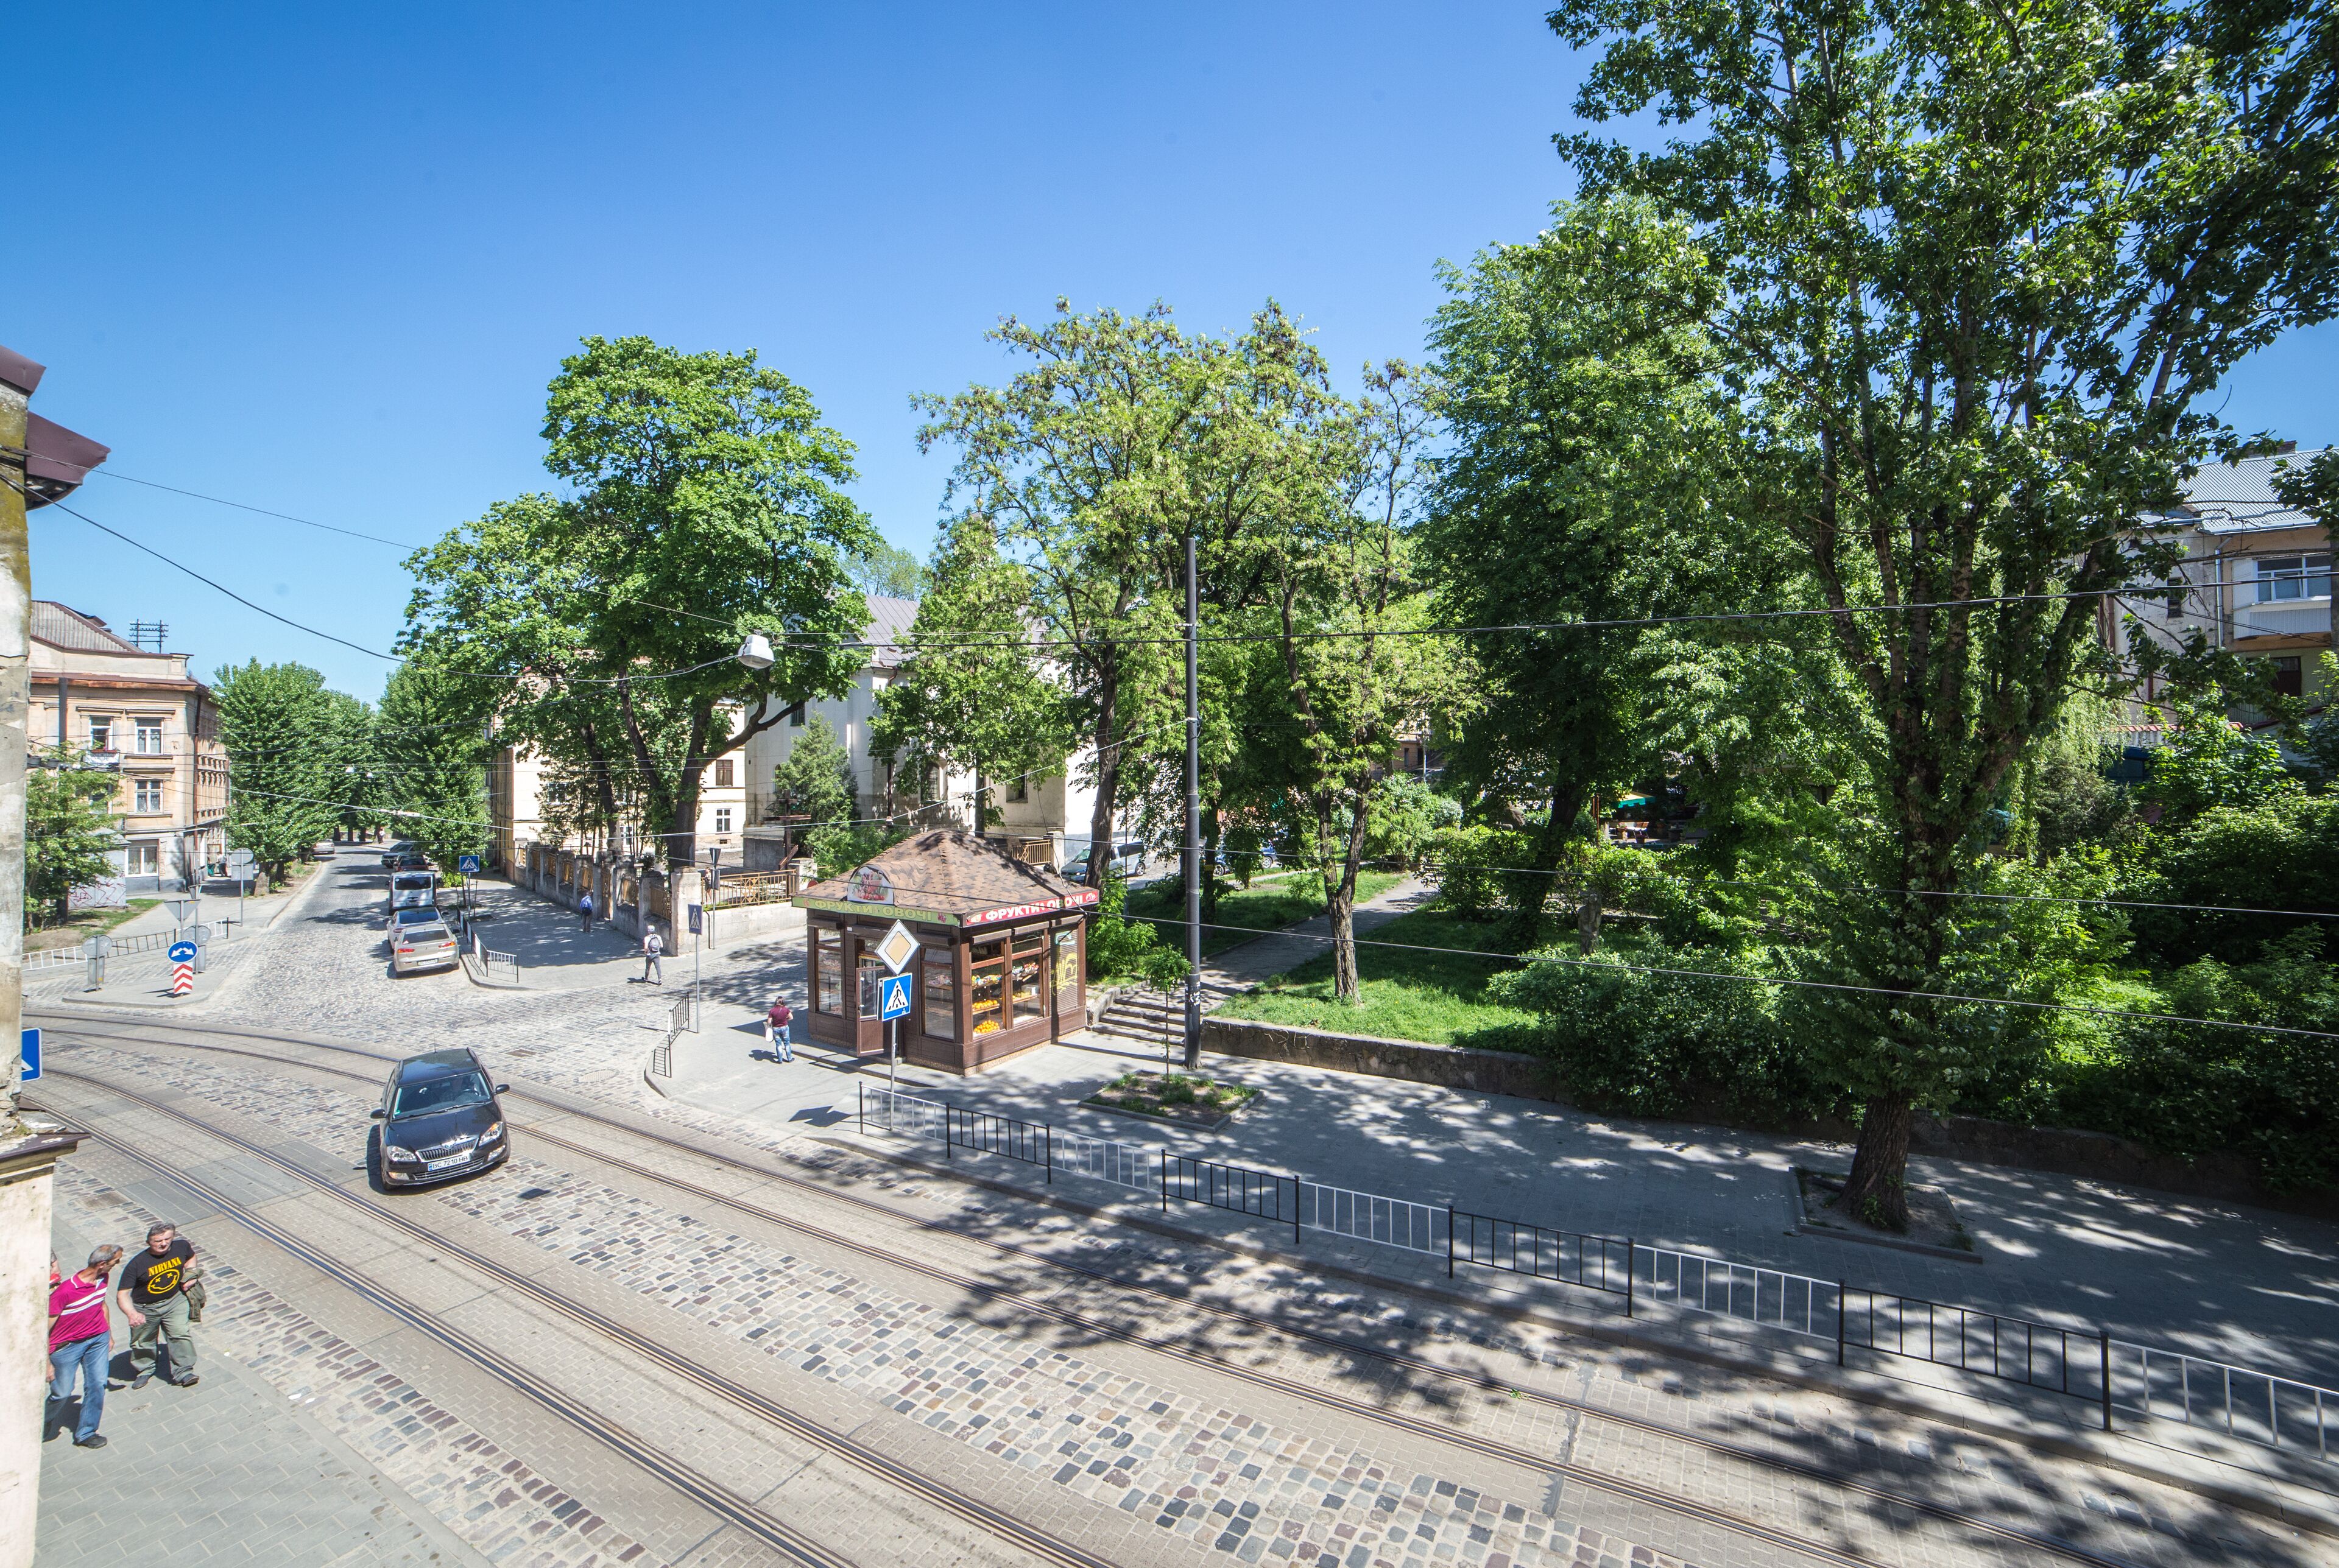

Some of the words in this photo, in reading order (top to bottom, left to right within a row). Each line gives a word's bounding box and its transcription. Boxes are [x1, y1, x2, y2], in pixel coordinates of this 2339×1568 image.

[814, 900, 873, 914] ФРУКТИ
[883, 906, 932, 921] ОВОЧІ
[986, 902, 1040, 921] ФРУКТИ
[1047, 895, 1083, 910] ОВОЧІ
[148, 1257, 182, 1277] NIRVANA
